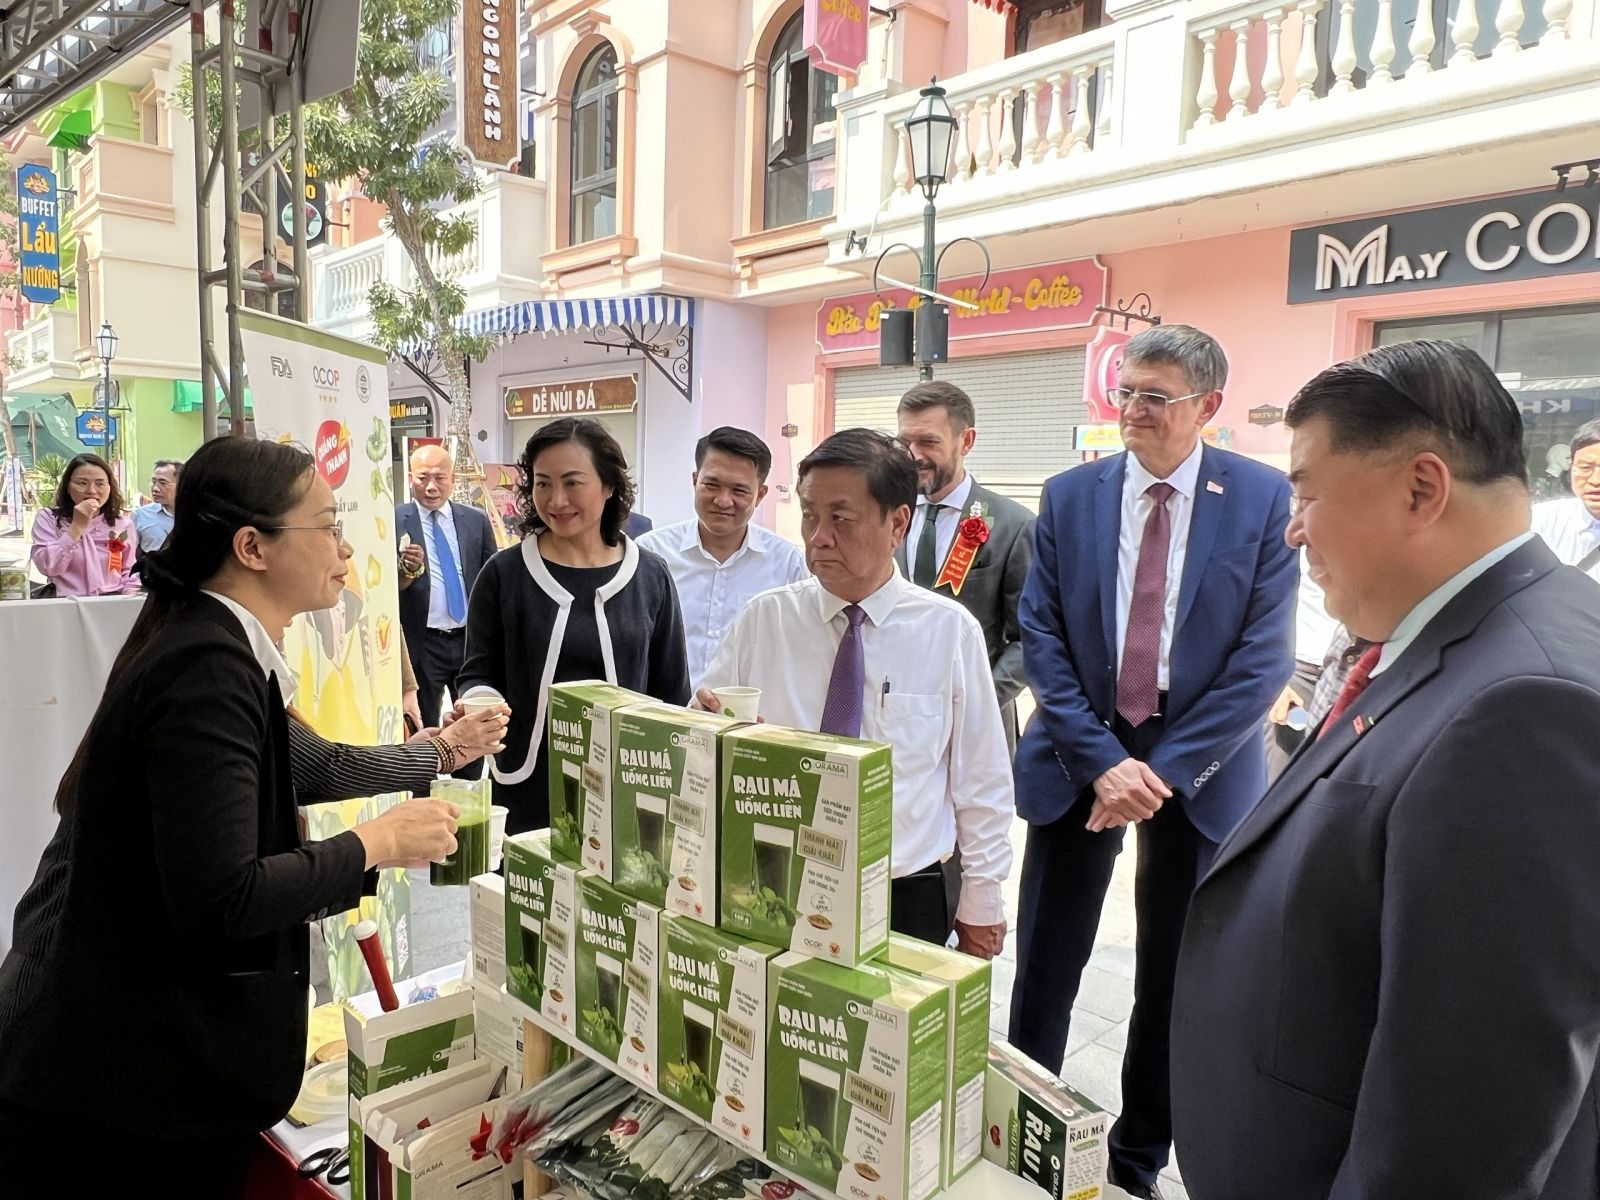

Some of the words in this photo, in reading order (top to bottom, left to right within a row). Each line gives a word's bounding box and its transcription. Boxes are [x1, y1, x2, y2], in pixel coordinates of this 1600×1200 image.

[21, 196, 55, 217] BUFFET
[1465, 202, 1600, 271] CO
[313, 366, 339, 387] OCOP
[532, 387, 547, 413] DÊ
[550, 385, 572, 411] NÚI
[576, 382, 596, 409] ĐÁ
[552, 718, 568, 738] RAU
[570, 720, 584, 739] MÁ
[620, 748, 650, 768] RAU
[651, 748, 673, 770] MÁ
[622, 770, 649, 787] UỐNG
[650, 769, 673, 789] LIỀN
[733, 774, 769, 796] RAU
[772, 774, 802, 798] MÁ
[735, 796, 771, 817] UỐNG
[773, 797, 802, 819] LIỀN
[509, 872, 528, 891] RAU
[529, 877, 545, 897] MÁ
[582, 907, 606, 931] RAU
[608, 916, 626, 936] MÁ
[668, 951, 695, 977] RAU
[698, 961, 720, 985] MÁ
[670, 973, 697, 996] UỐNG
[778, 1004, 816, 1032] RAU
[818, 1015, 848, 1043] MÁ
[780, 1029, 817, 1055] UỐNG
[818, 1038, 849, 1064] LIỀN
[1024, 1110, 1043, 1174] RAU
[1069, 1128, 1089, 1143] RAU
[1091, 1121, 1105, 1137] MÁ
